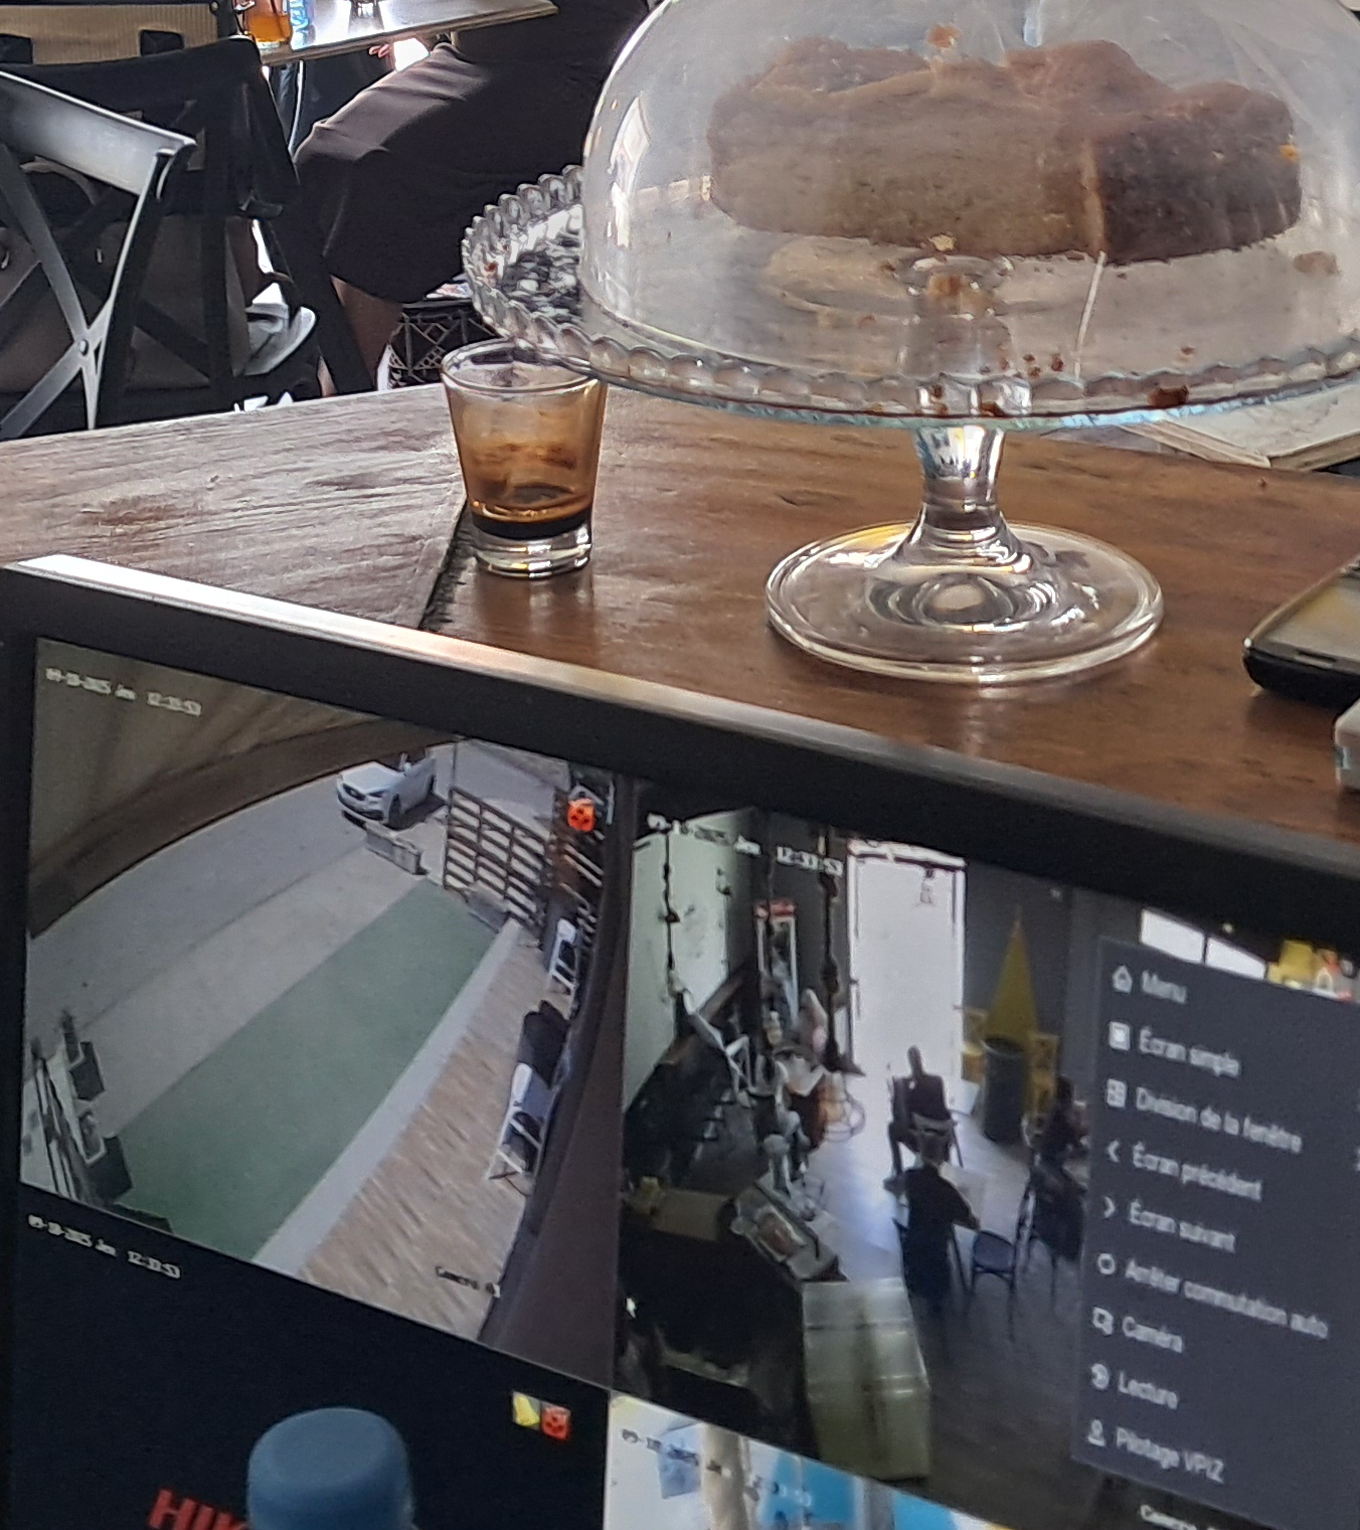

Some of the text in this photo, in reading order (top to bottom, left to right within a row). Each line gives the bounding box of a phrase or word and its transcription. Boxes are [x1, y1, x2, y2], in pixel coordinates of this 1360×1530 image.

[1142, 970, 1187, 1004] Menu
[1200, 1106, 1222, 1131] de
[1223, 1110, 1239, 1136] la
[1118, 1371, 1178, 1410] Lecture
